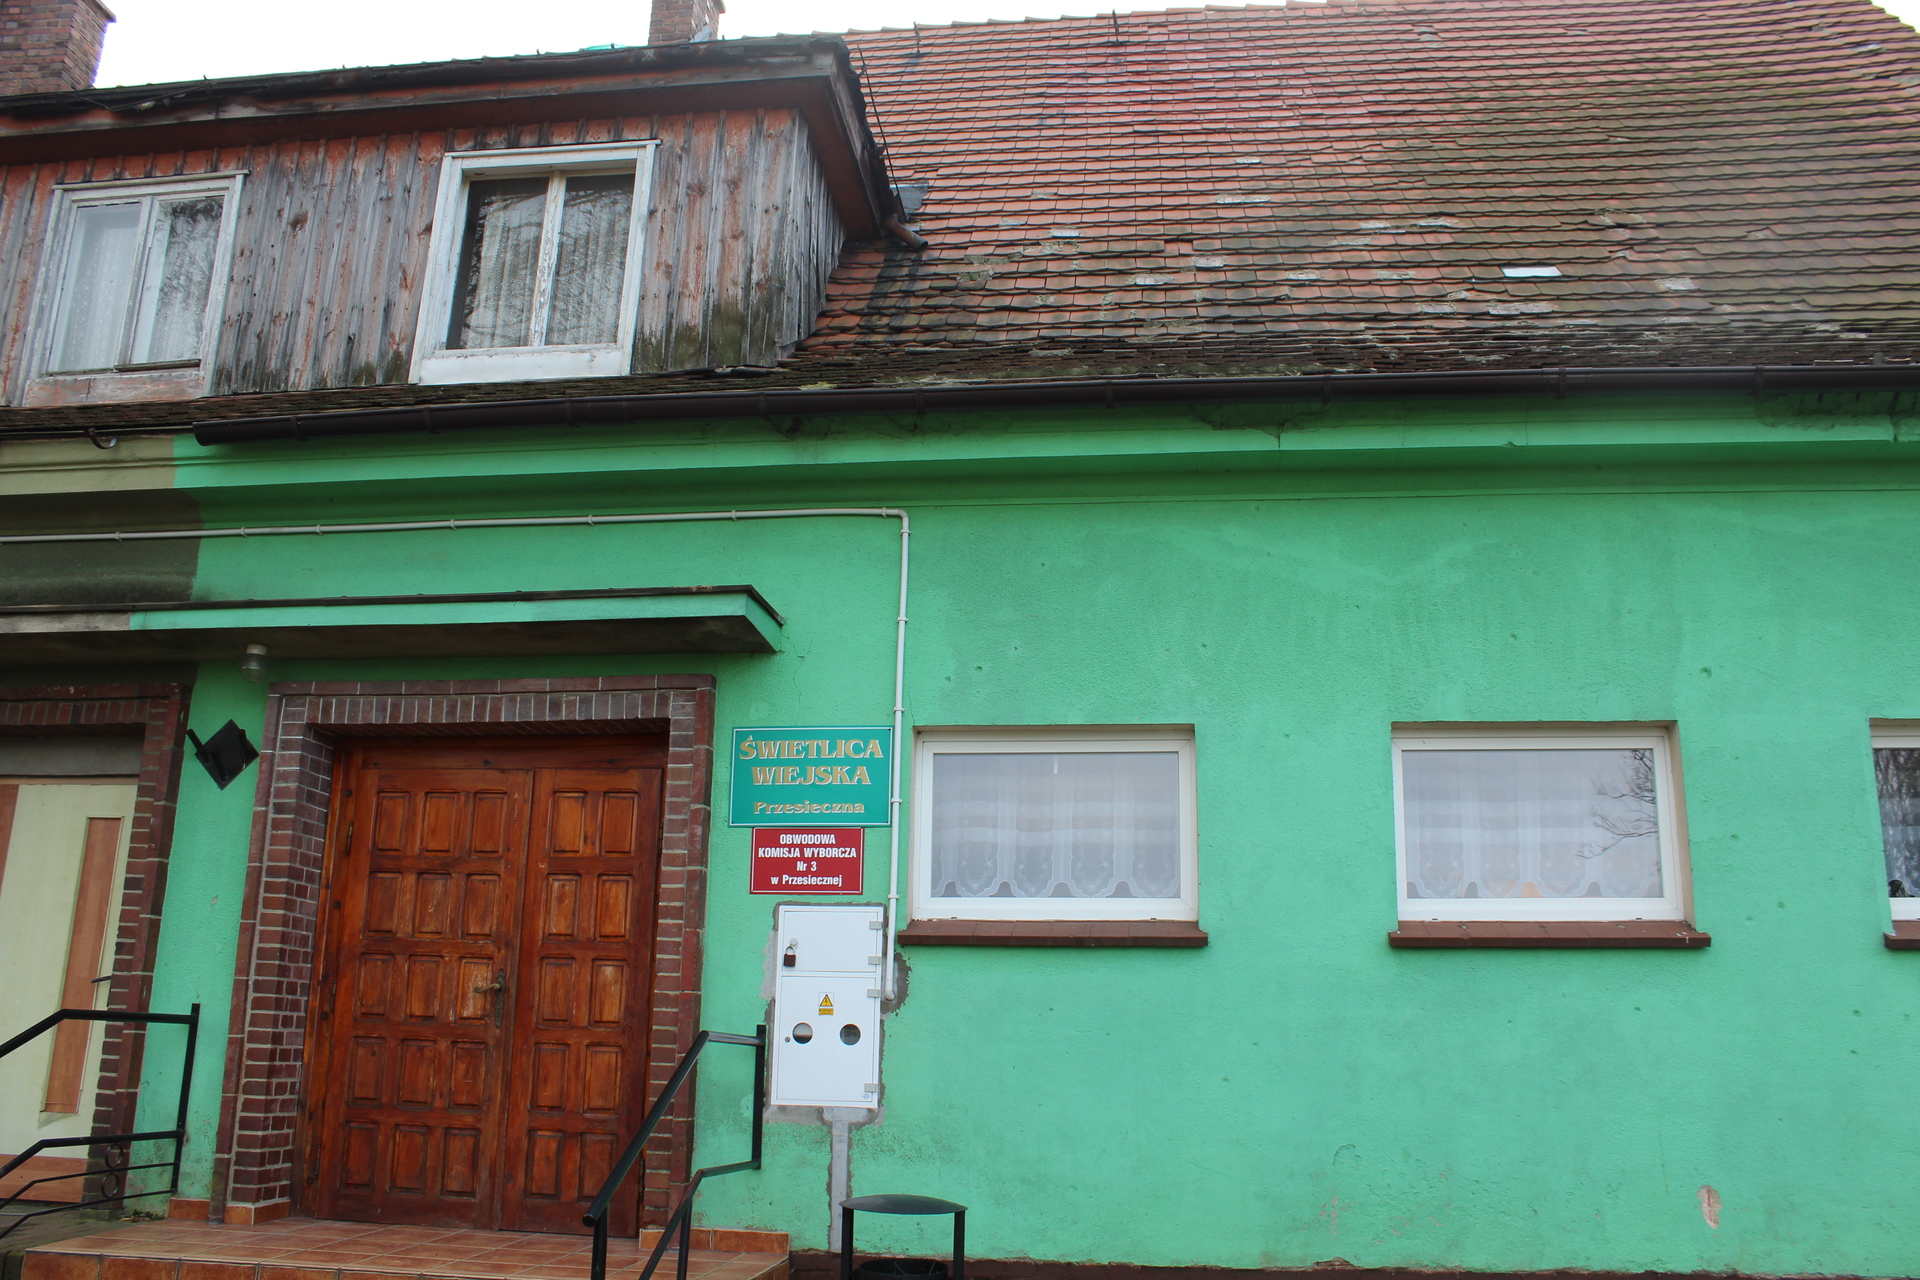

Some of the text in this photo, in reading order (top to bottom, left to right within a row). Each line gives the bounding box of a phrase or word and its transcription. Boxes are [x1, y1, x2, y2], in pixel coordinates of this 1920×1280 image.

[739, 735, 884, 760] ŚWIETLICA
[751, 765, 872, 785] WIEJSKA
[753, 800, 865, 815] Przesieczna
[779, 834, 836, 844] OBWODOWA
[758, 847, 857, 858] KOMISJA WYBORCZA
[796, 861, 817, 871] Nr 3
[782, 874, 843, 887] Przesiecznej
